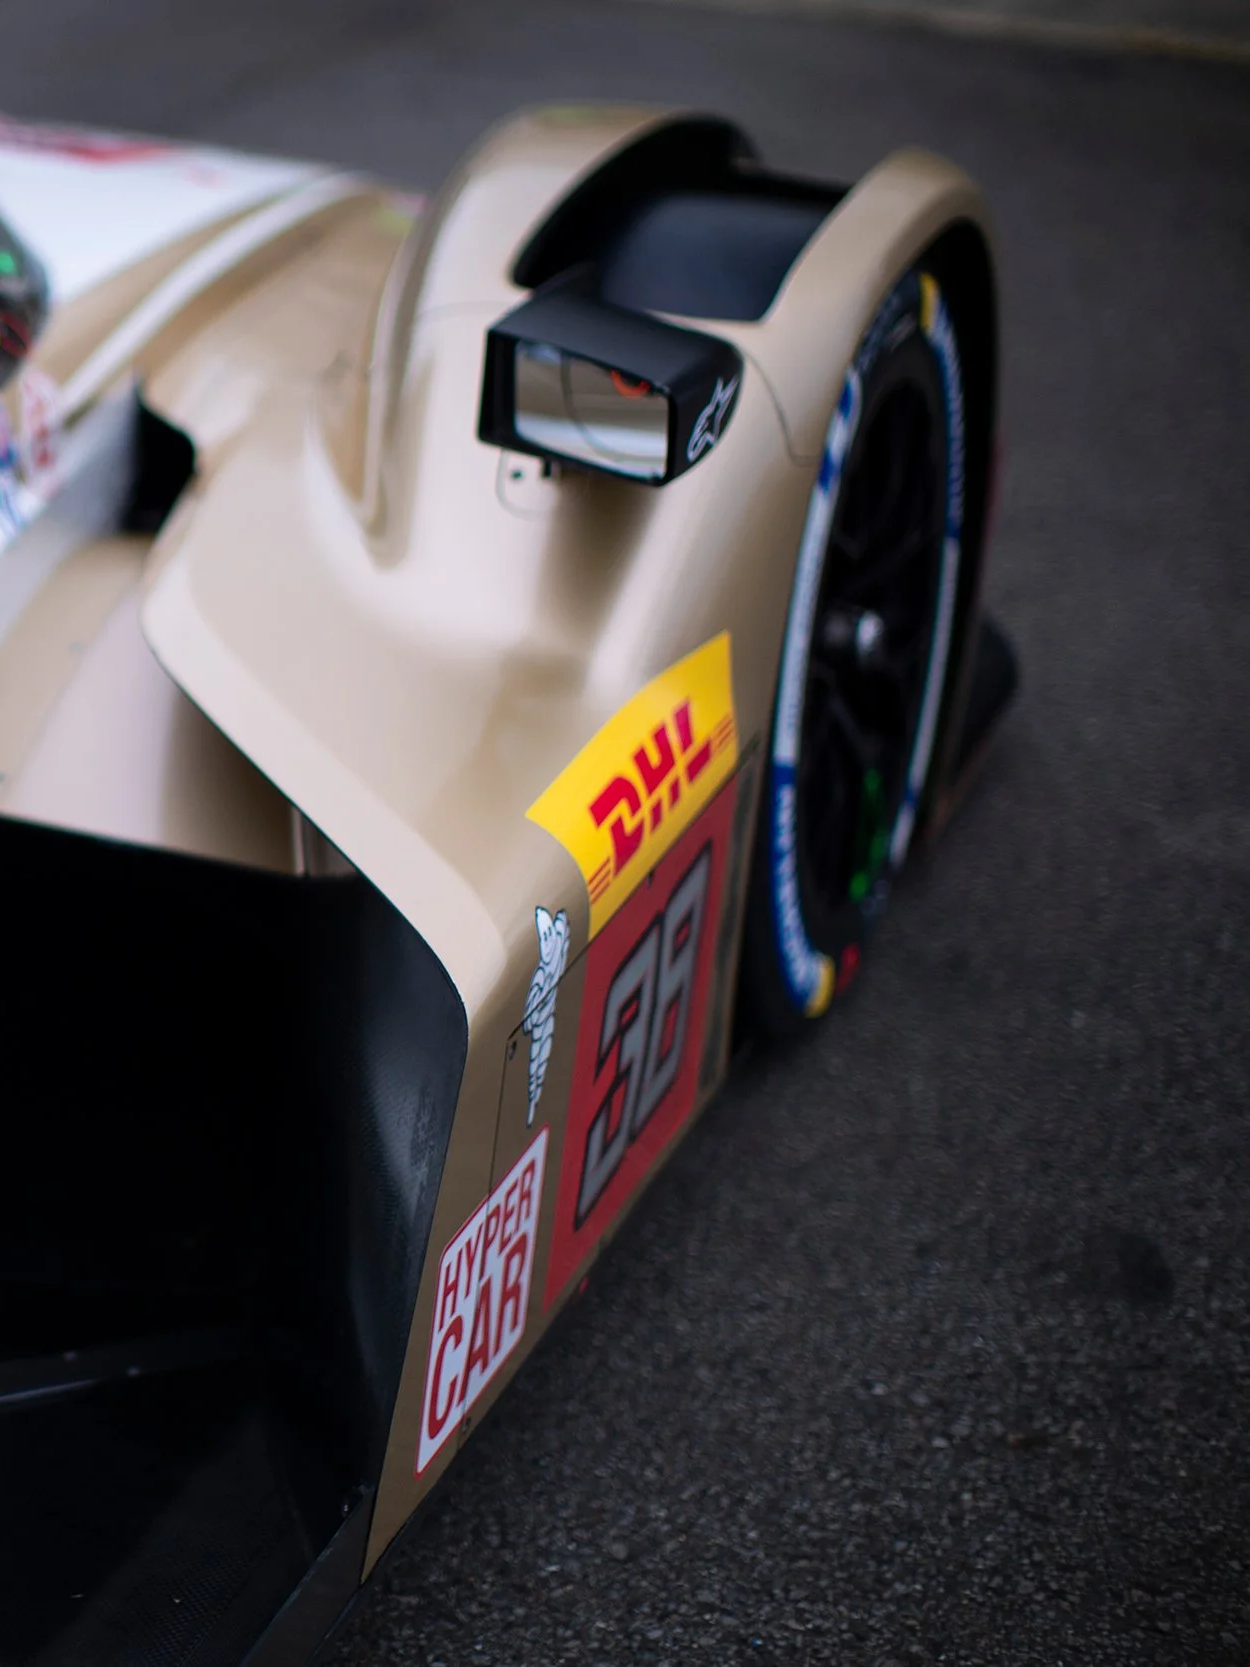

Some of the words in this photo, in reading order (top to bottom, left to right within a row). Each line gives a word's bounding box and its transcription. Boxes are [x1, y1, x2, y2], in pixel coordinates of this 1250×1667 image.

[588, 697, 712, 878] DHL
[575, 838, 713, 1231] 38
[427, 1232, 528, 1440] CAR
[438, 1158, 536, 1332] HYPER
